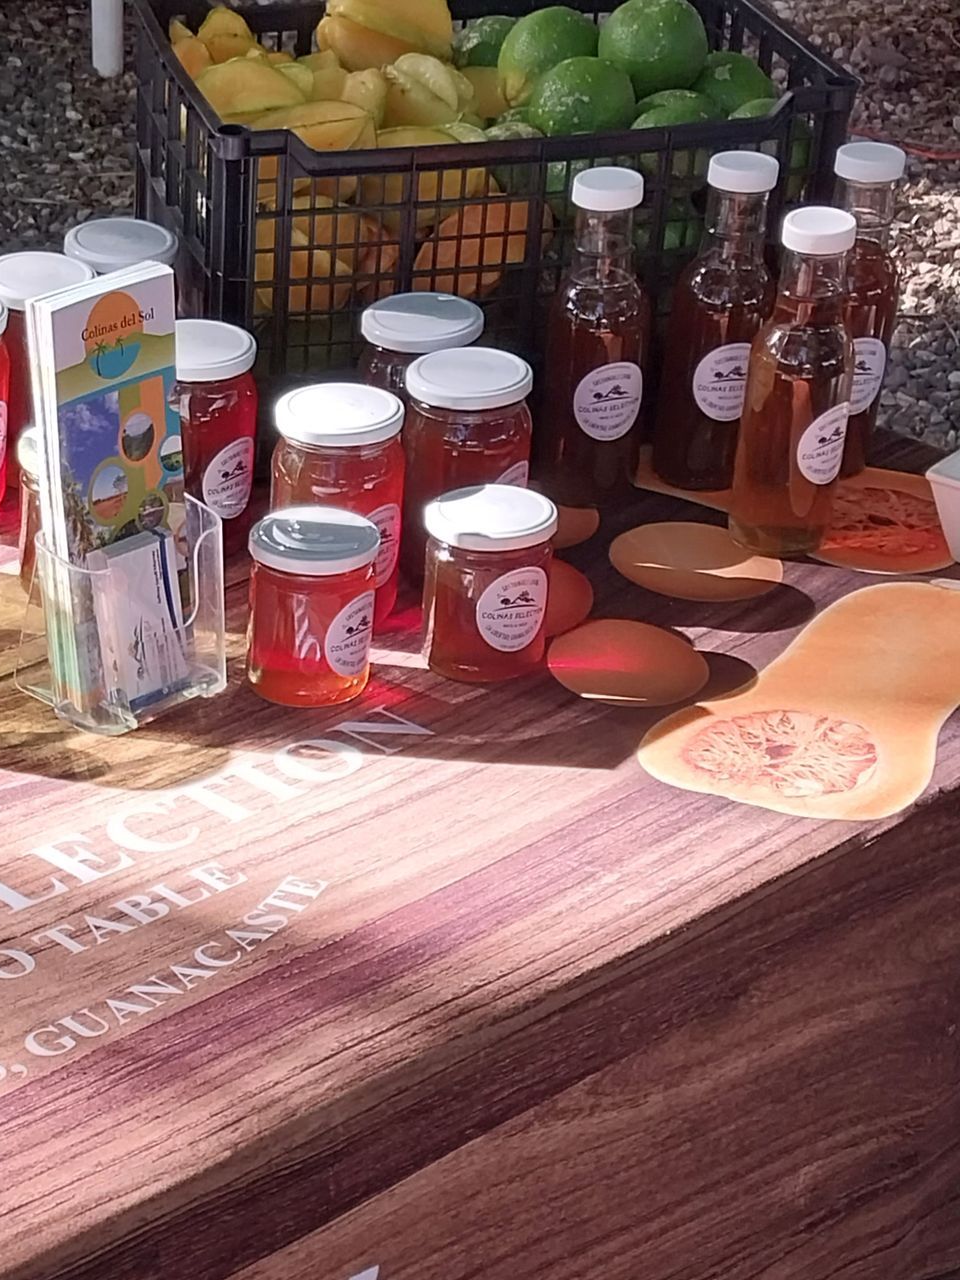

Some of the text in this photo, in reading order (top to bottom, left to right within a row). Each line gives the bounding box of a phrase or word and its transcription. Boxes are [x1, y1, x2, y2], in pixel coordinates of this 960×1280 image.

[81, 307, 155, 341] Colinas del Sol
[32, 862, 249, 954] TABLE
[24, 875, 331, 1058] GUANACASTE
